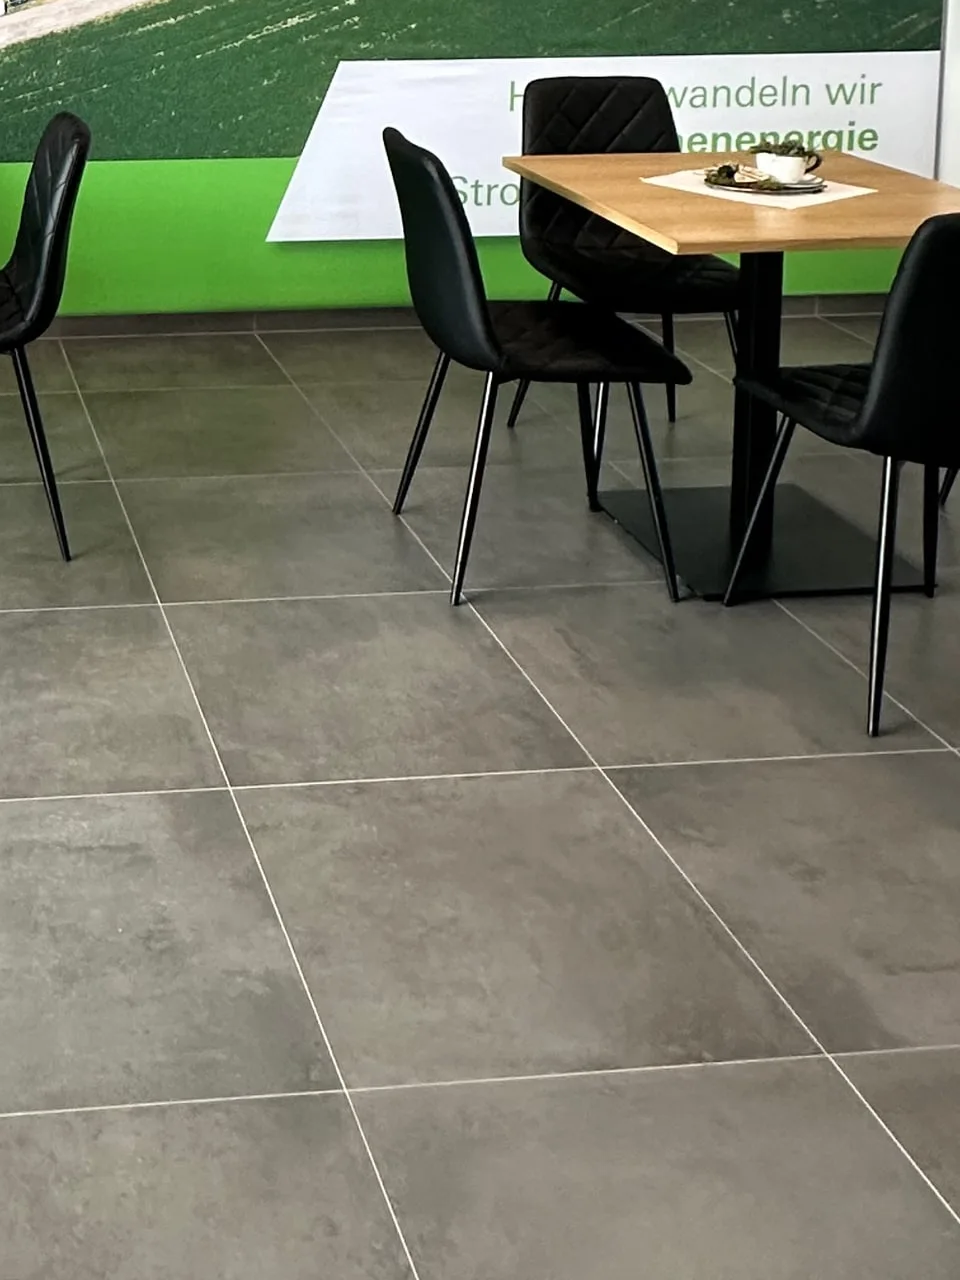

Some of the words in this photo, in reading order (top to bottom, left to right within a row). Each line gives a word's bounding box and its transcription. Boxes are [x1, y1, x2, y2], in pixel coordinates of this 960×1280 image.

[667, 76, 811, 108] wandeln
[825, 74, 882, 106] wir
[677, 121, 879, 153] enenergie
[451, 175, 520, 207] Stro
